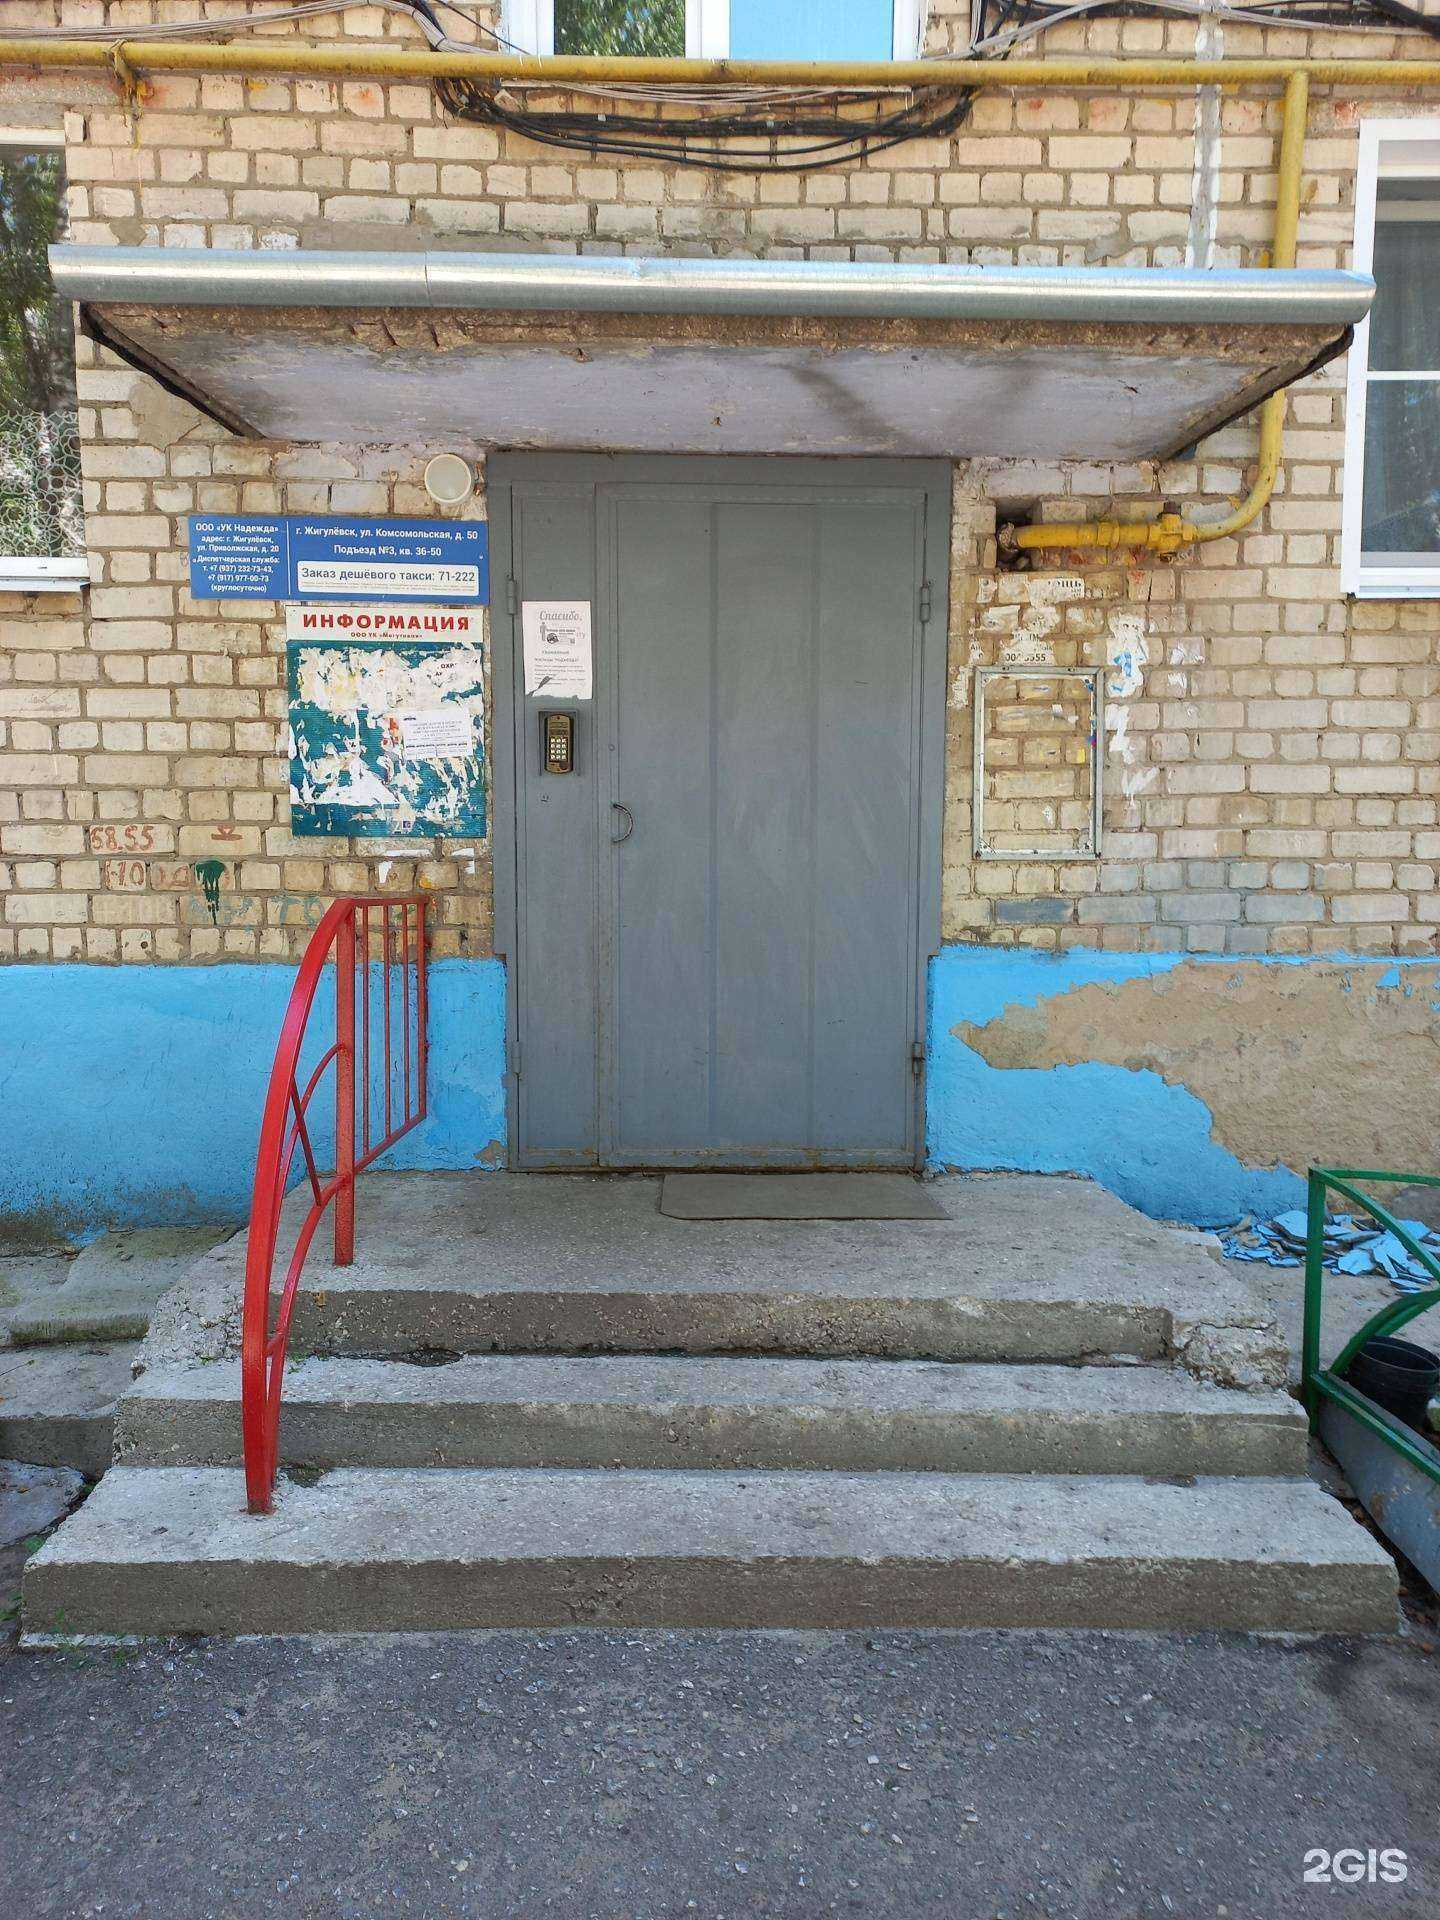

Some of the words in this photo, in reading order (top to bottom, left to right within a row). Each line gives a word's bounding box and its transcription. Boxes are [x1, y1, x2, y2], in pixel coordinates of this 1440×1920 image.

[234, 524, 278, 533] Надежда»
[304, 526, 357, 538] Жигулёвск,
[376, 528, 452, 540] Комсомольская,
[455, 532, 464, 541] д.
[467, 531, 478, 539] 50
[334, 545, 376, 556] Подъезд
[378, 546, 396, 556] №3,
[416, 547, 441, 556] 36-50
[301, 568, 336, 578] Заказ
[340, 568, 396, 580] дешёвого
[400, 572, 435, 581] такси:
[438, 572, 476, 582] 71-222
[303, 613, 469, 632] ИНФОРМАЦИЯ
